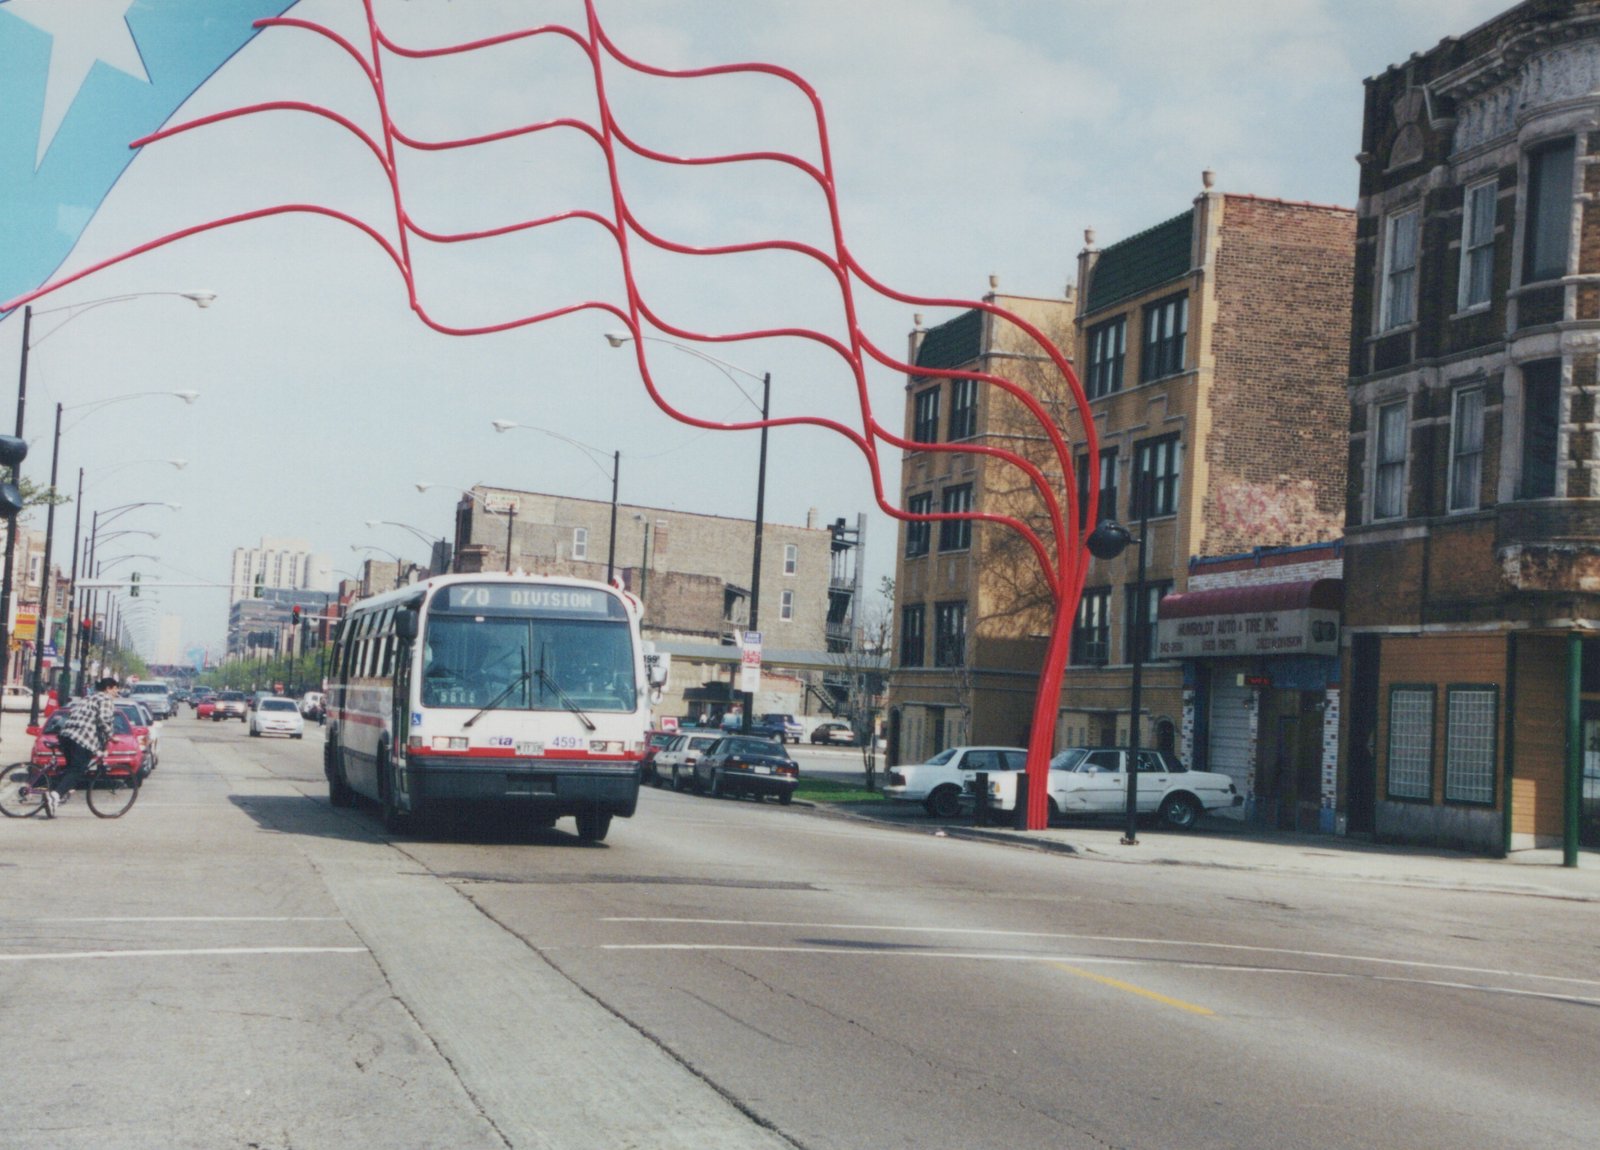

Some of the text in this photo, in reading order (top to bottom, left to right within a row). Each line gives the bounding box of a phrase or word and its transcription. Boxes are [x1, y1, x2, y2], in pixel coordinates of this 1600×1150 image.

[460, 587, 592, 608] 70 DIVISION
[1177, 620, 1214, 637] HUMBOLDT
[1218, 619, 1237, 634] AUTO
[1245, 618, 1262, 633] TIRE
[552, 736, 583, 748] 4591
